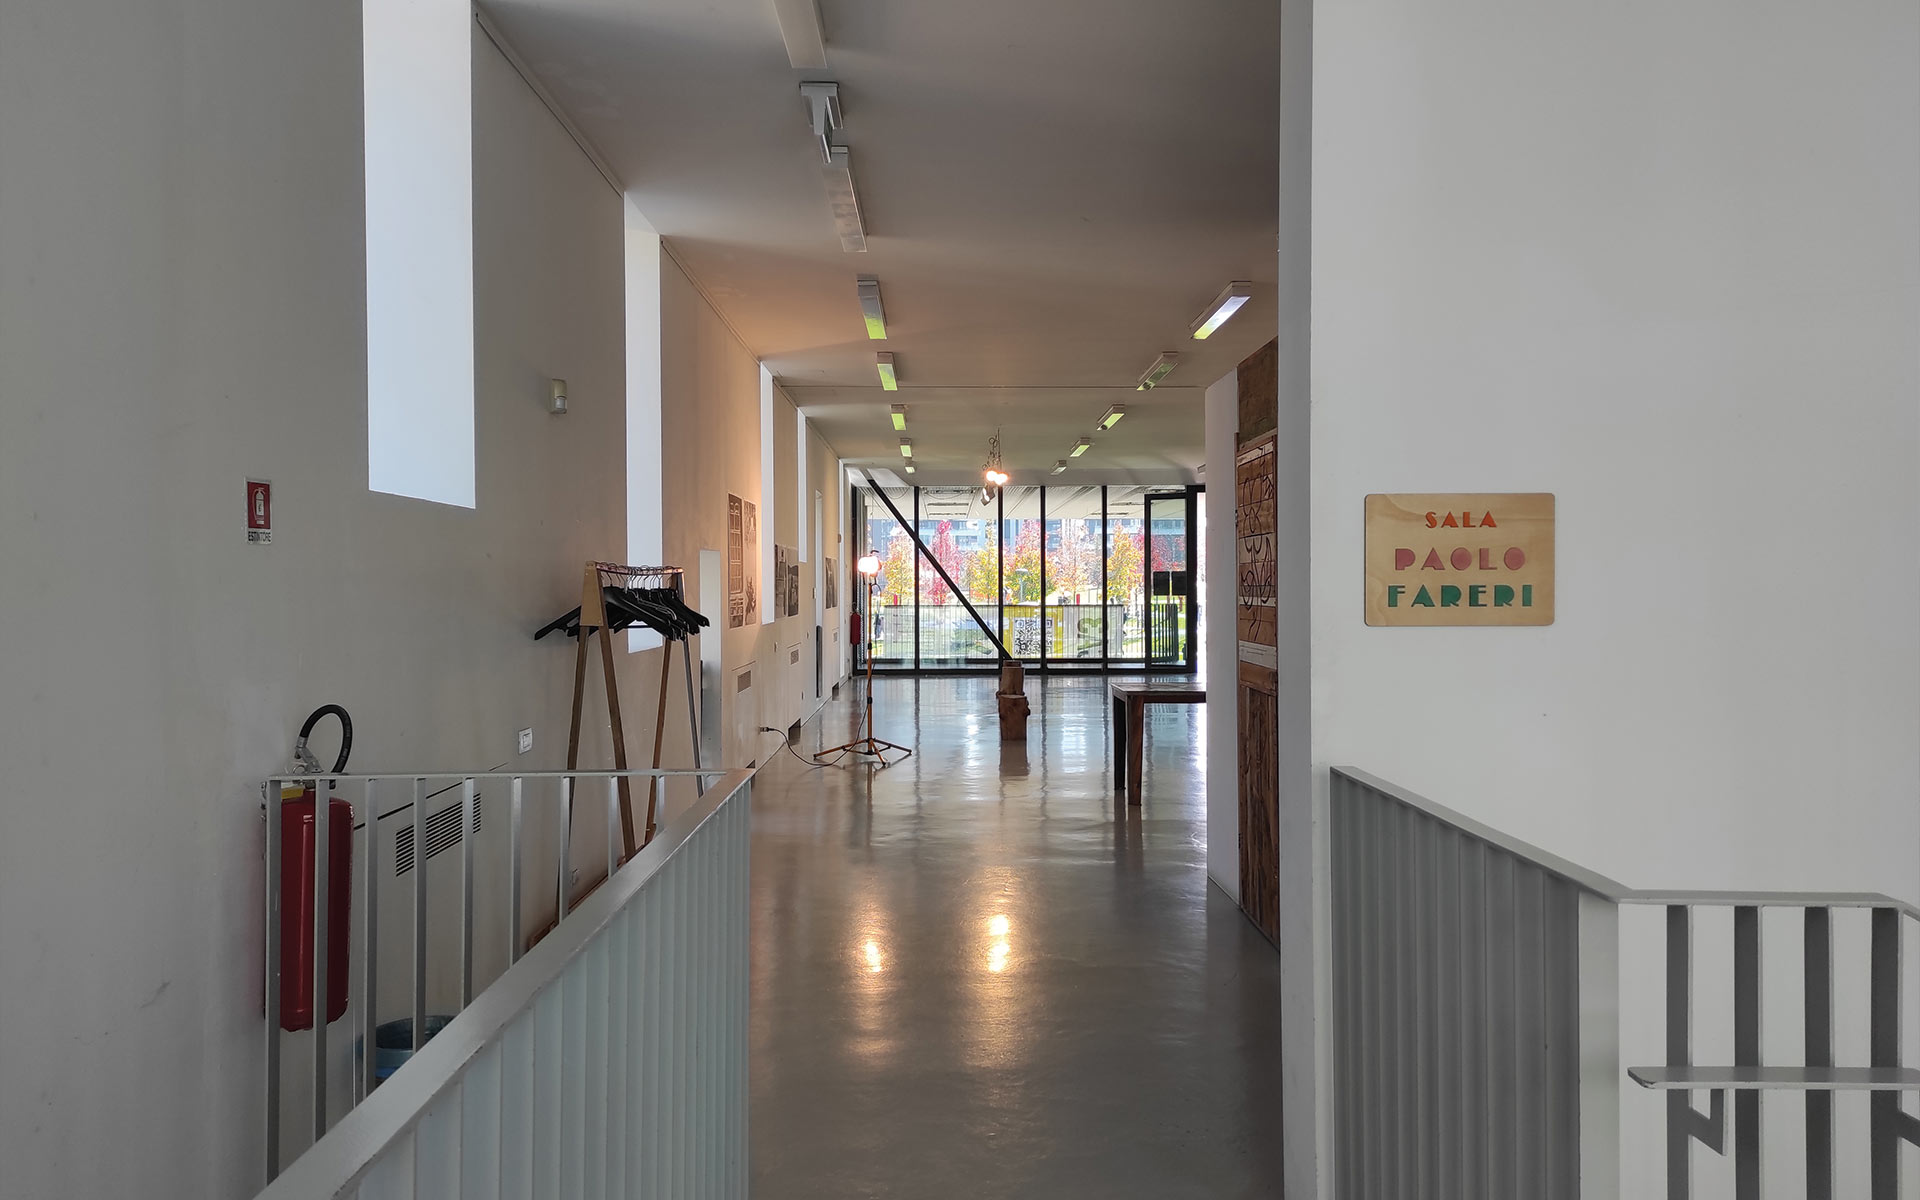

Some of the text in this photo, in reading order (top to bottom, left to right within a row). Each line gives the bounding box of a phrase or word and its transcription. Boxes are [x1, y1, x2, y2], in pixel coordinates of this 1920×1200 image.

[1425, 511, 1497, 528] SALA
[1395, 547, 1526, 571] PAOLO
[1388, 585, 1533, 608] FARERI
